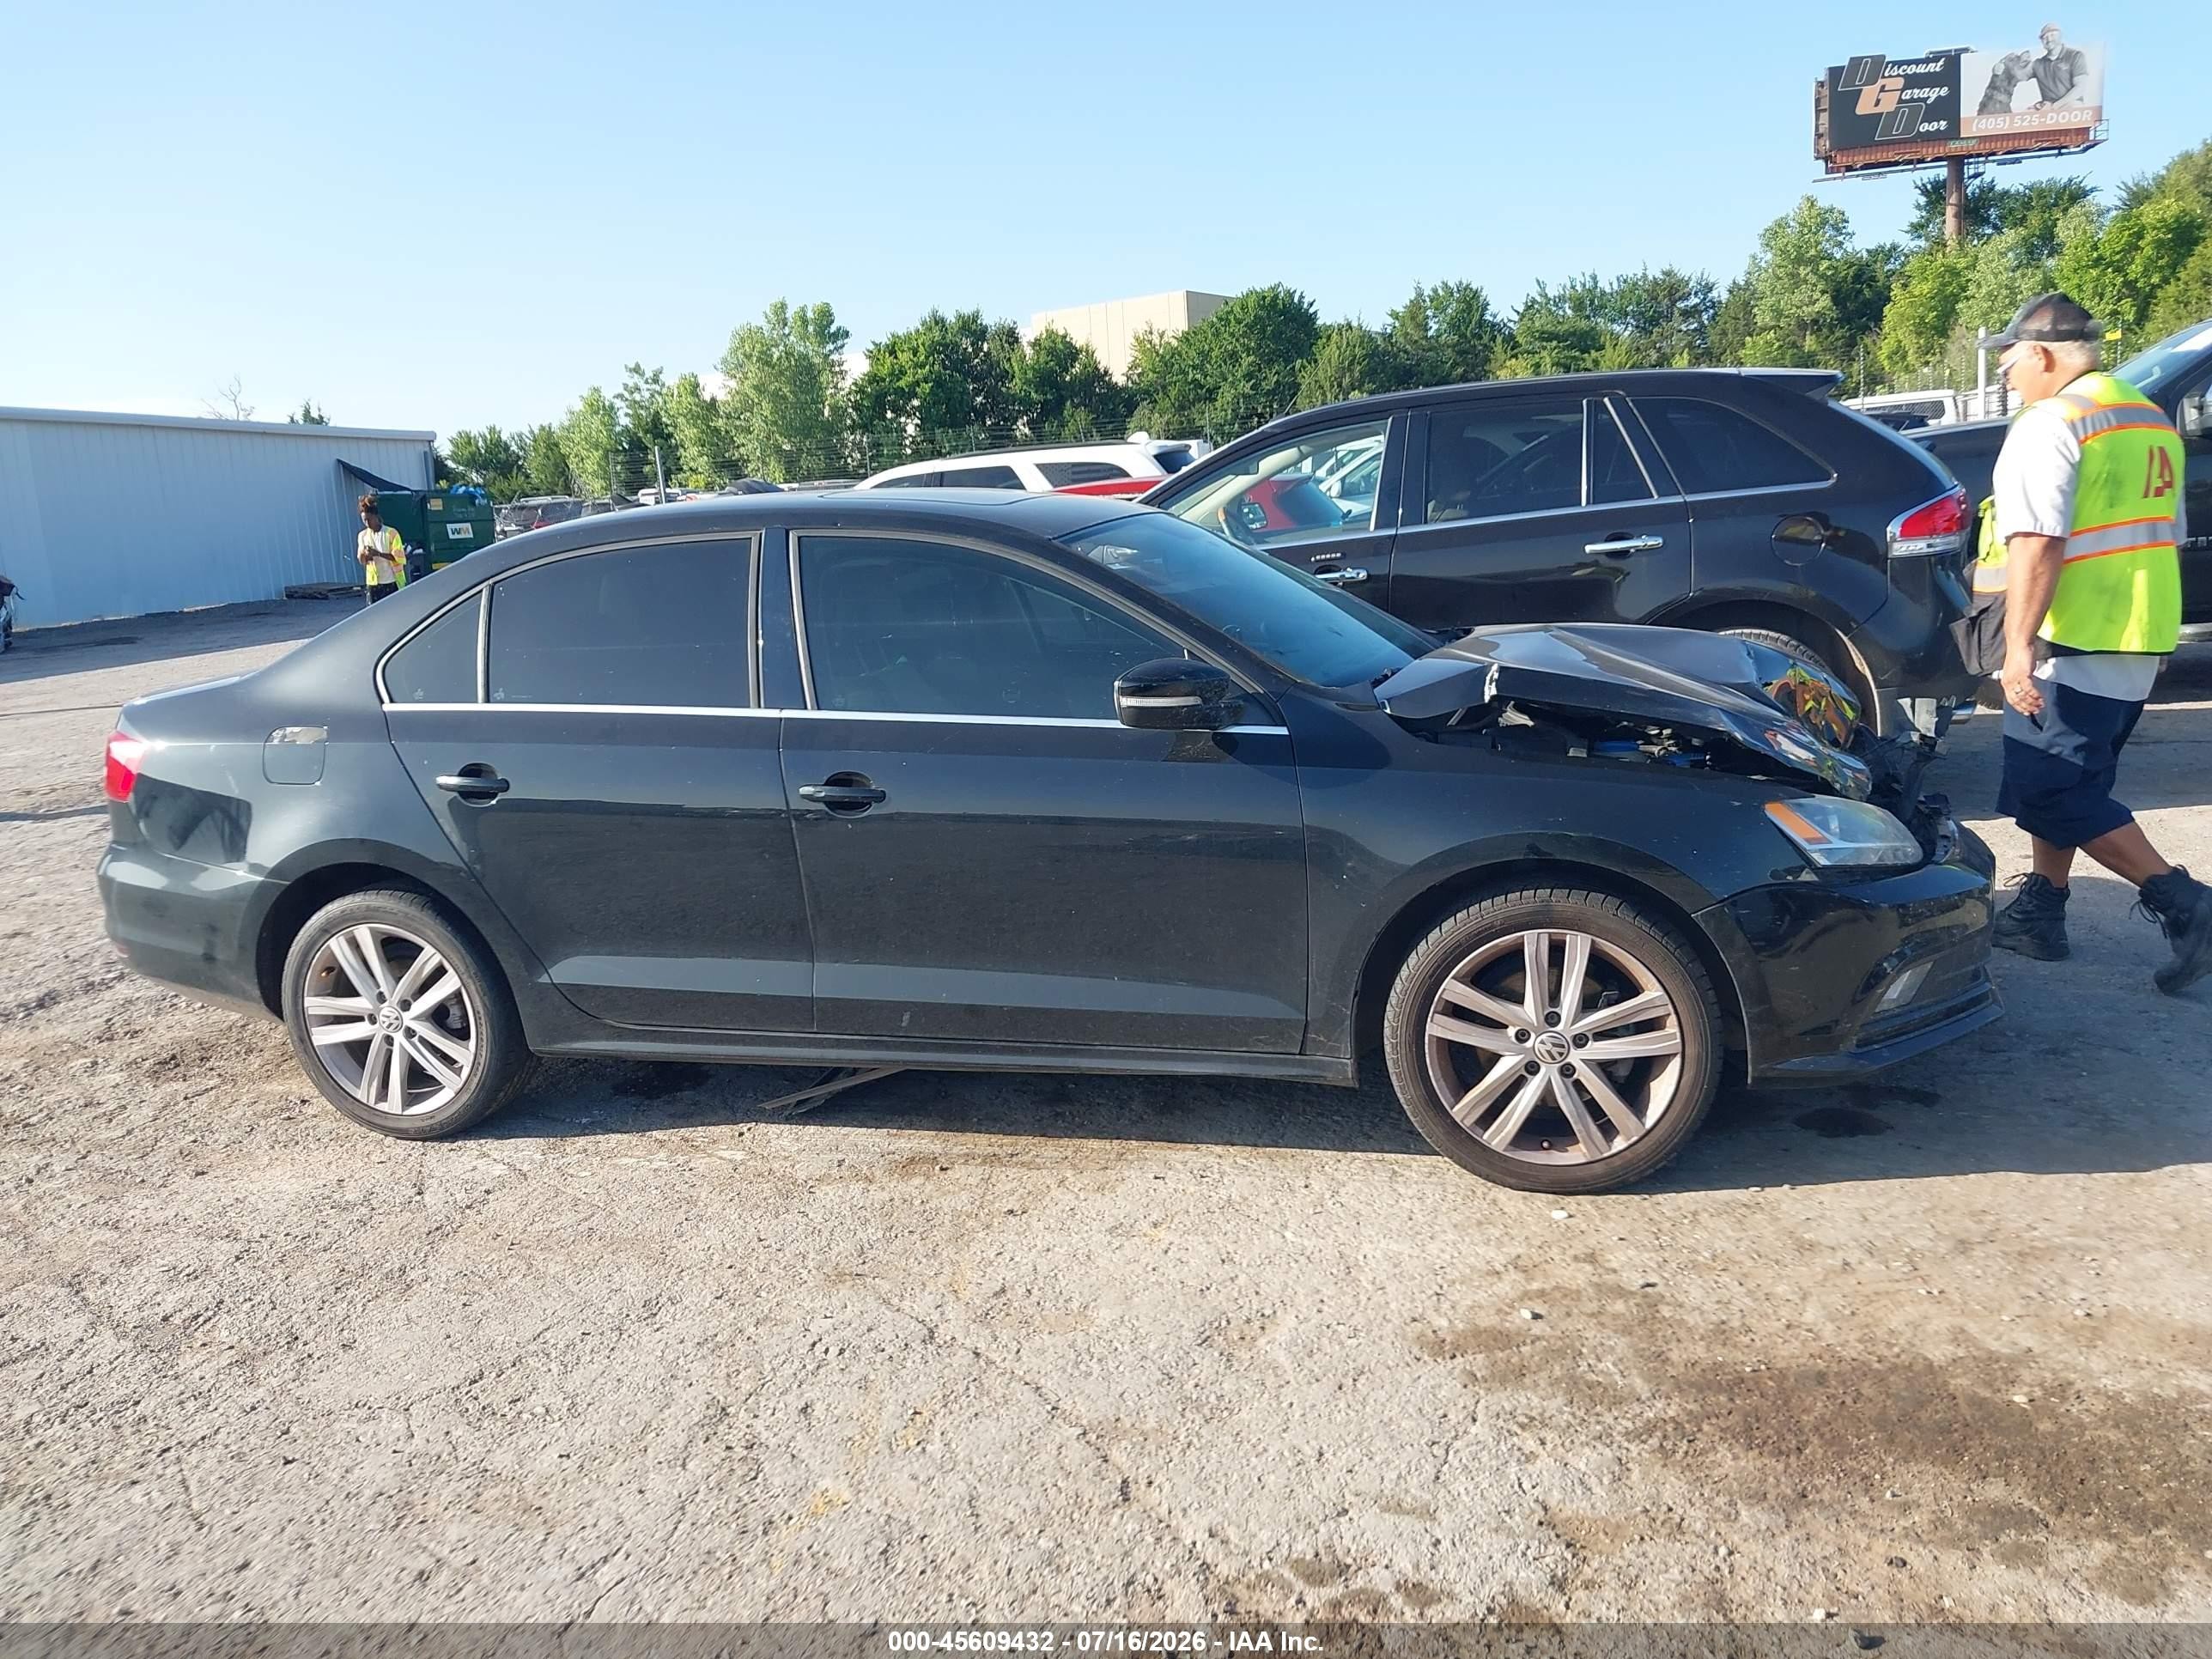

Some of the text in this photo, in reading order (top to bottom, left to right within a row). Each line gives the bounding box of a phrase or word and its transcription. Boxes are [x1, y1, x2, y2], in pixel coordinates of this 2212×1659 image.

[1838, 54, 1946, 91] Discount
[1855, 76, 1950, 115] Garage
[1875, 102, 1949, 140] Door
[1972, 109, 2093, 131] (405) 525-DOOR
